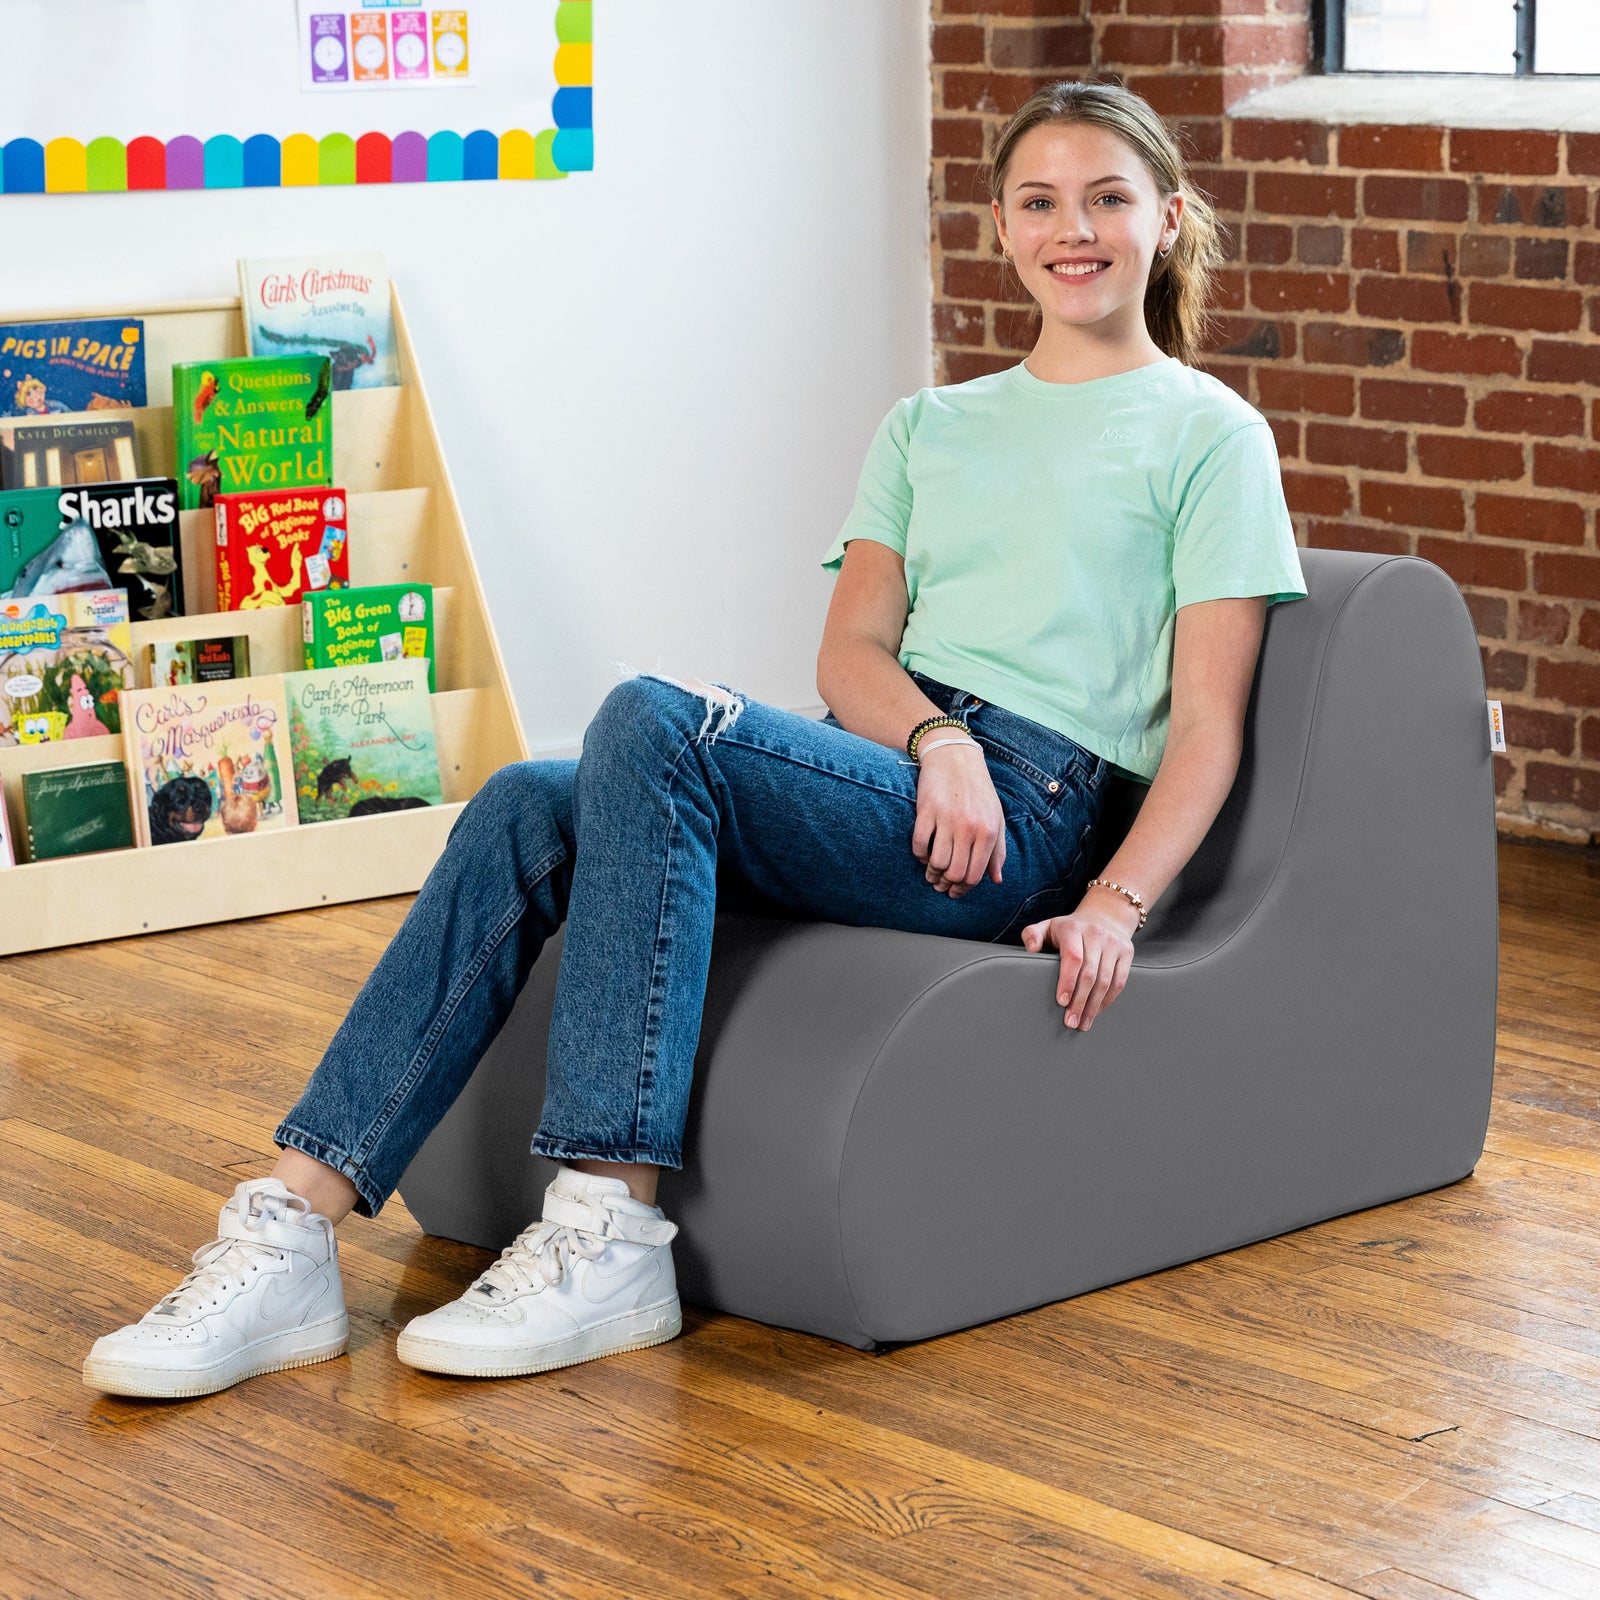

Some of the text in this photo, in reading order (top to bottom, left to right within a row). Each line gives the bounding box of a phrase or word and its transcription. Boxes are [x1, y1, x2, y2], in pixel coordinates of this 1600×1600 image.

[301, 268, 372, 303] Christmas
[2, 336, 136, 371] PIGS IN SPACE
[228, 370, 312, 393] Questions
[214, 398, 303, 416] & Answers
[17, 430, 47, 441] KATE
[217, 418, 323, 451] Natural
[224, 450, 325, 485] World
[58, 486, 176, 530] Sharks
[238, 502, 254, 513] The
[238, 504, 270, 535] BIG
[269, 499, 292, 517] Red
[293, 497, 320, 513] Book
[260, 515, 317, 539] of Beginner
[276, 528, 310, 550] Books
[325, 598, 341, 608] The
[324, 604, 352, 628] BIG
[355, 603, 392, 619] Green
[336, 621, 379, 640] Book of
[326, 638, 376, 659] Beginner
[334, 653, 370, 667] Books
[302, 675, 414, 708] Carl's Afternoon
[136, 693, 207, 733] Carl's
[320, 702, 331, 715] in
[332, 698, 349, 717] the
[1491, 706, 1501, 731] JAXX
[150, 694, 277, 759] Masquerade
